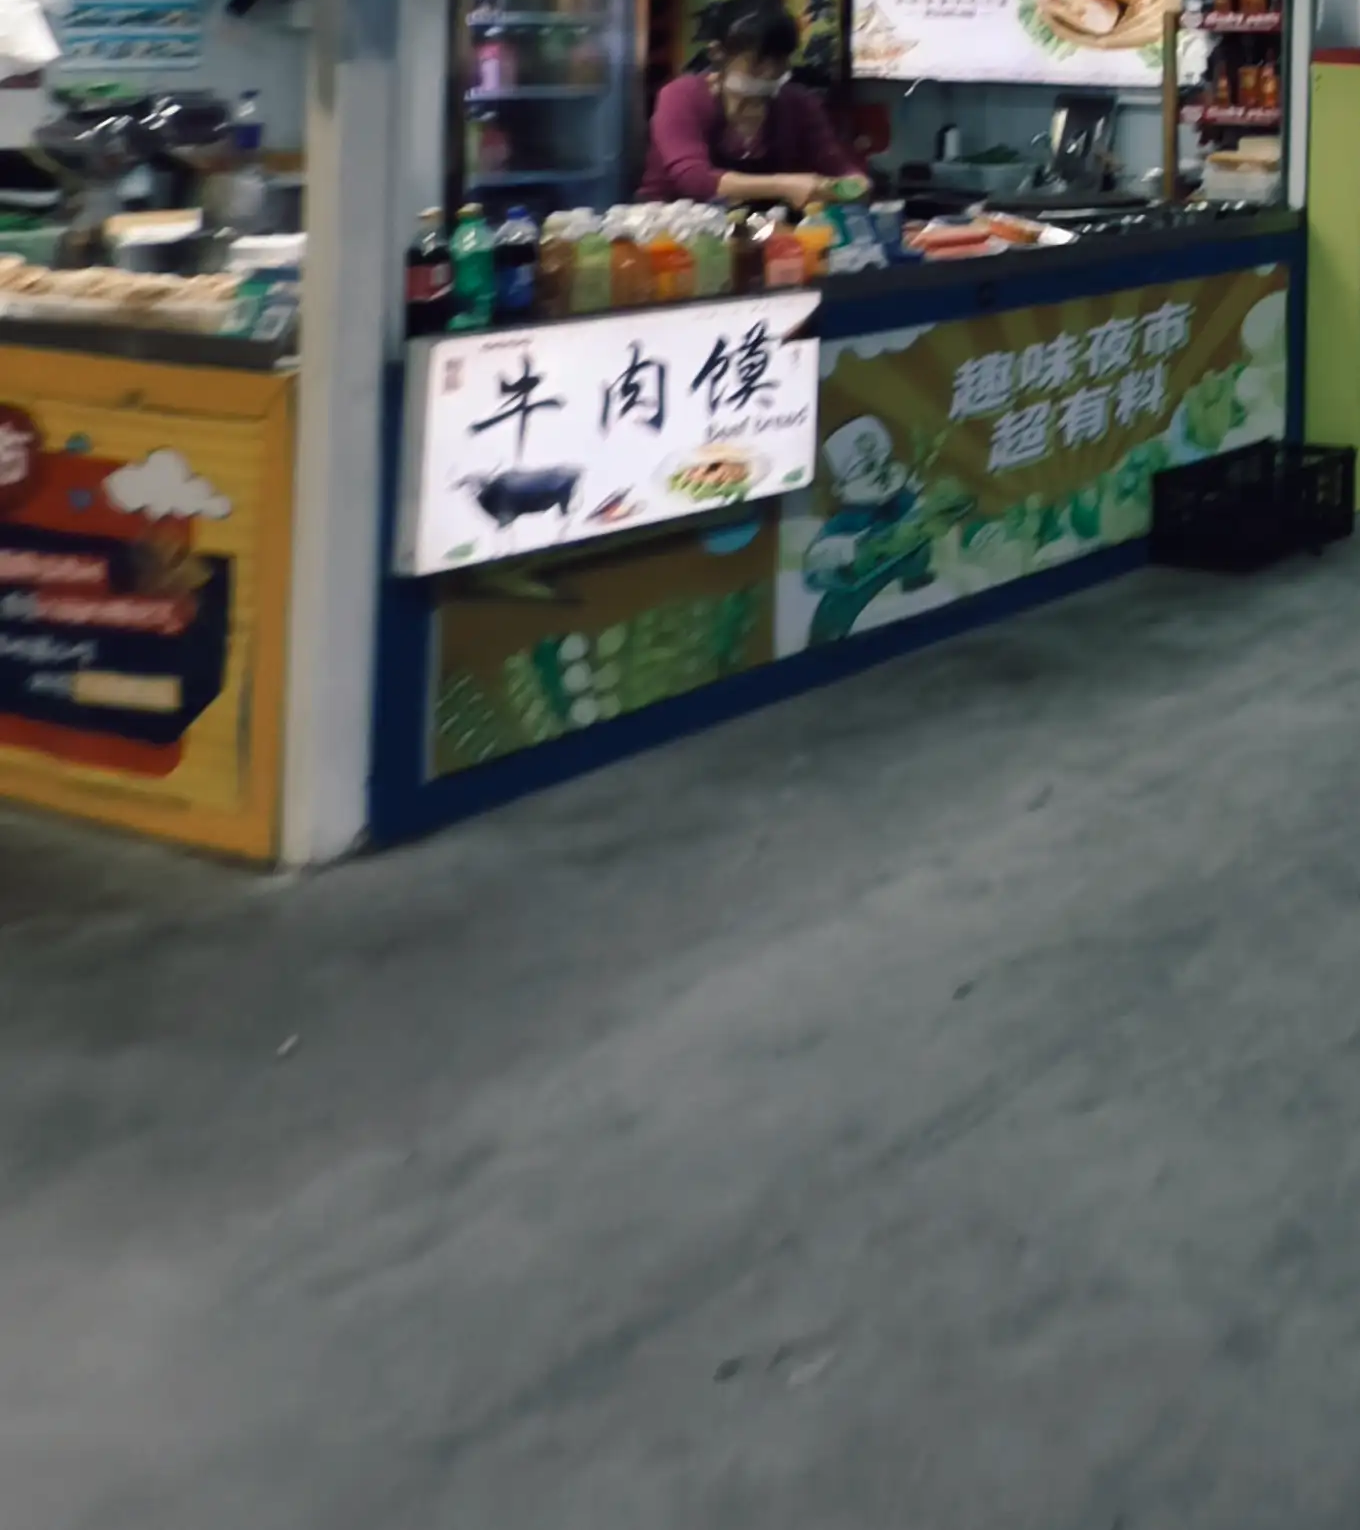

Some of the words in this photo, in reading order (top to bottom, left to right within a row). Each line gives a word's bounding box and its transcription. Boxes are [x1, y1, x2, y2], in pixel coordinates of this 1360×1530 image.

[467, 320, 779, 462] 牛肉馍
[947, 301, 1196, 422] 趣味夜市
[985, 361, 1169, 473] 超有料
